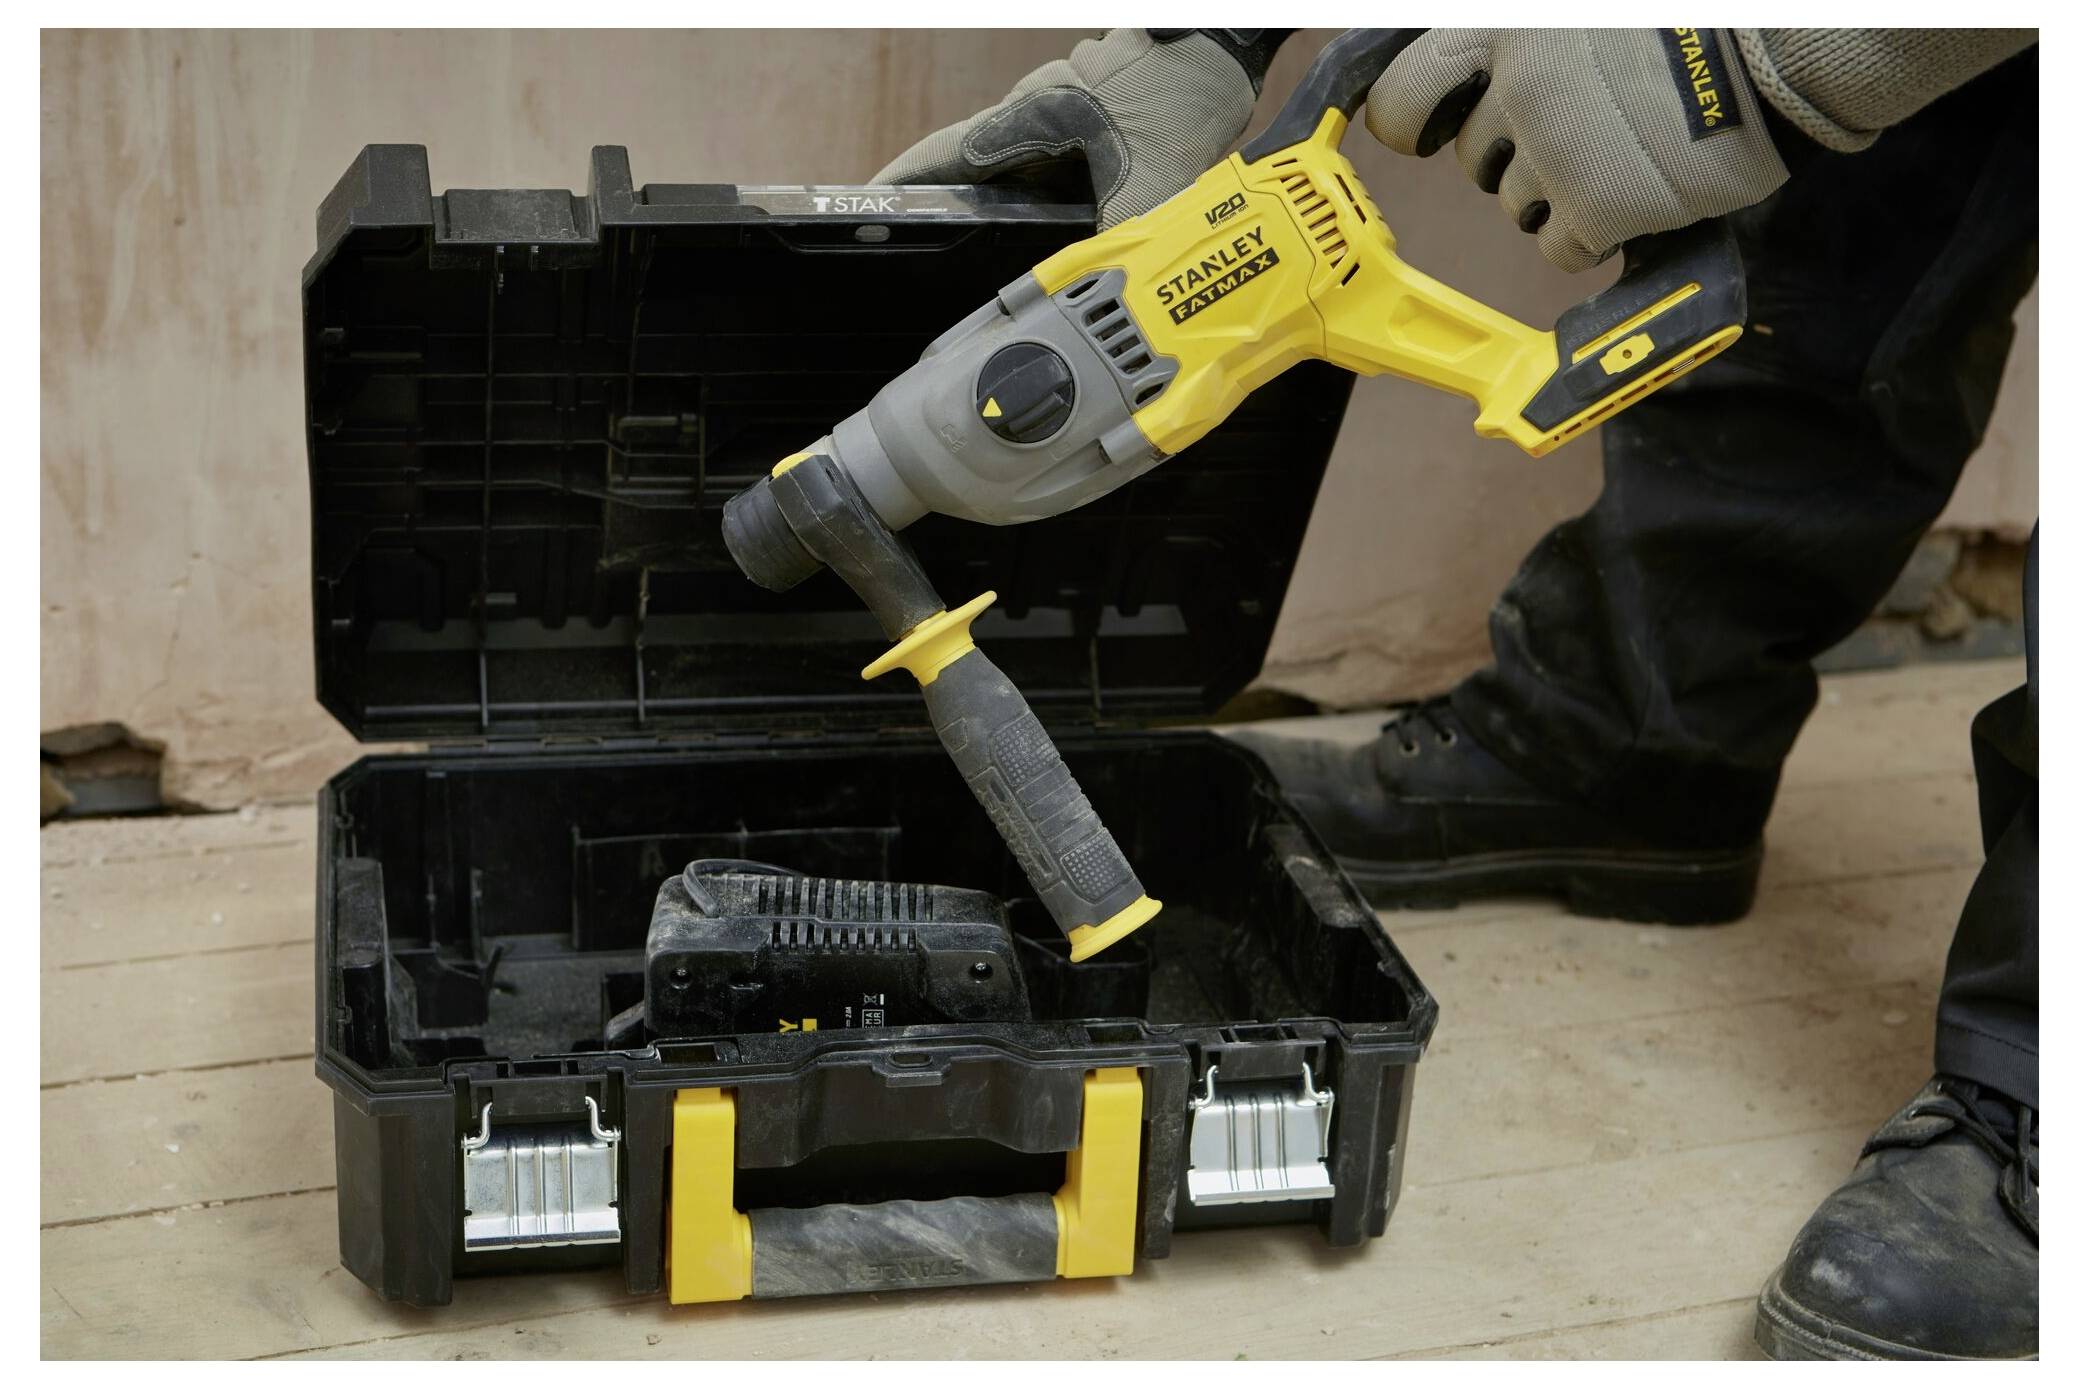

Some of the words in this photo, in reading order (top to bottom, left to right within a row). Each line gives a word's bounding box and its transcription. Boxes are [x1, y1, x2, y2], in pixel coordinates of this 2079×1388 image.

[1204, 192, 1246, 225] V20
[1156, 225, 1264, 305] STANLEY
[1175, 254, 1273, 319] FATMAX
